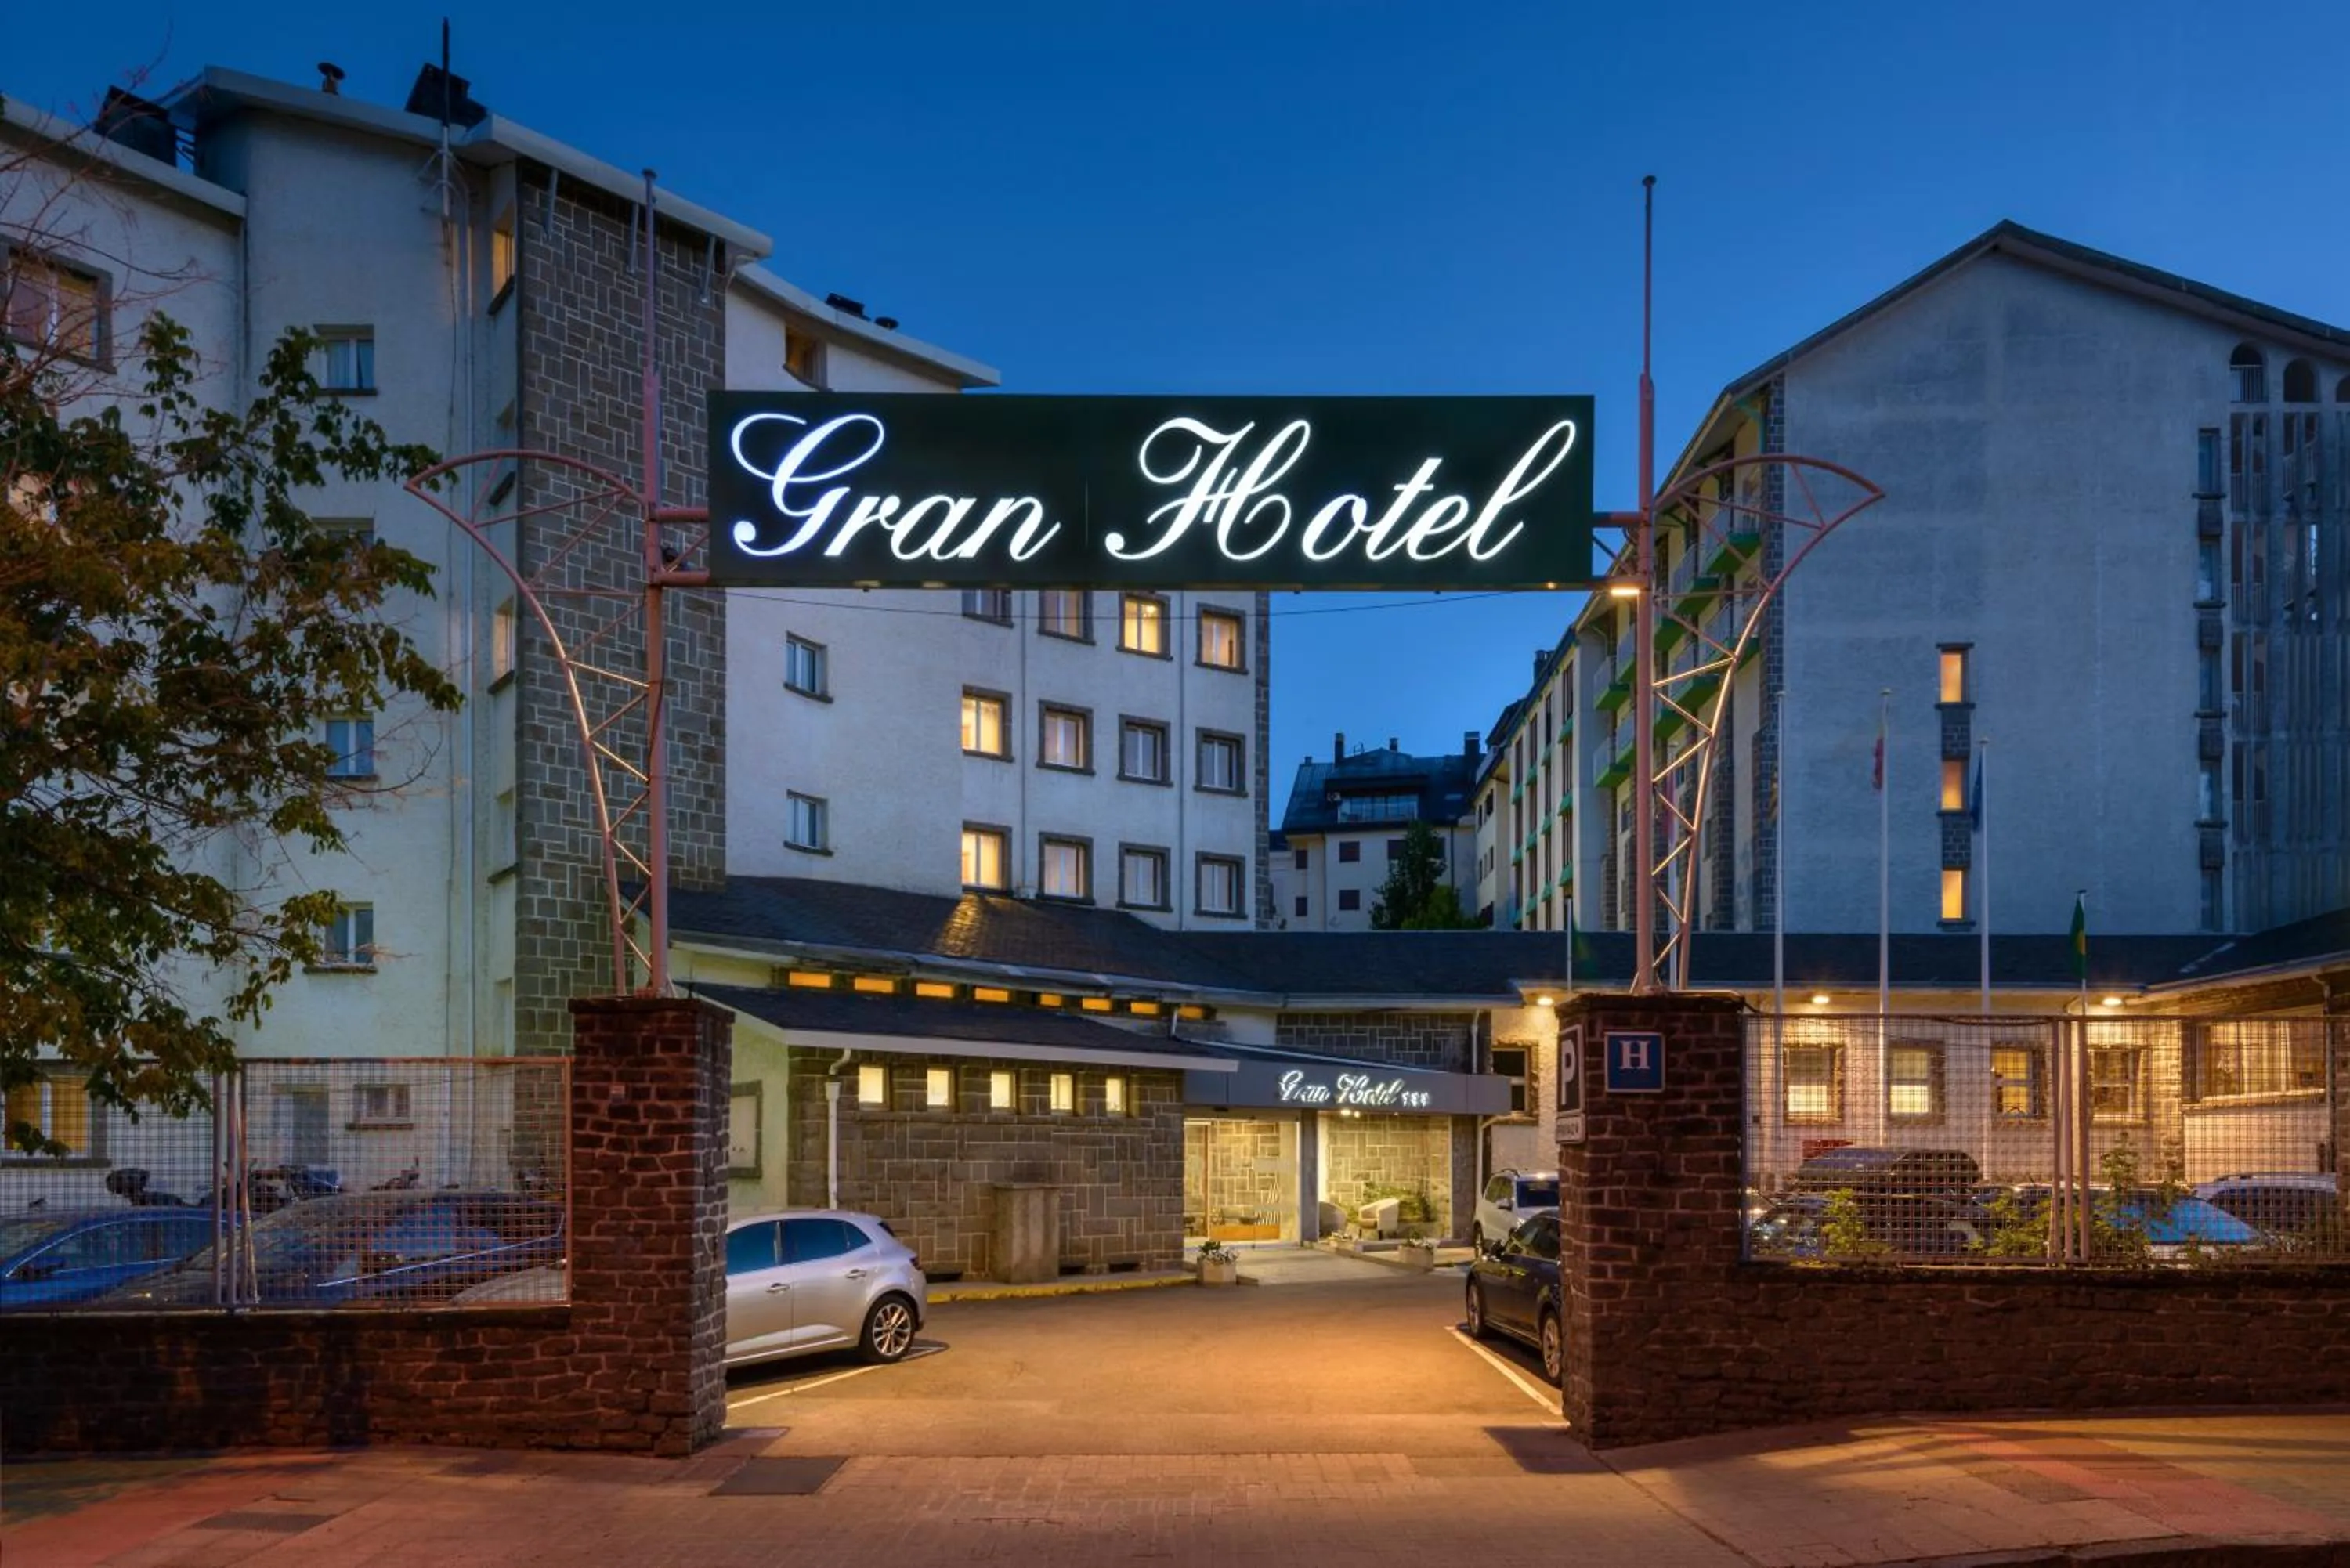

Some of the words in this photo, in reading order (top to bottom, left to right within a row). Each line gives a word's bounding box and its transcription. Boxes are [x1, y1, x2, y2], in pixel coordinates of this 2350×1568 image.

[730, 412, 1061, 562] Gran
[1104, 417, 1577, 562] Hotel
[1561, 1039, 1576, 1105] P
[1619, 1040, 1650, 1069] H
[1279, 1069, 1331, 1103] Gran
[1336, 1073, 1405, 1105] Hotel
